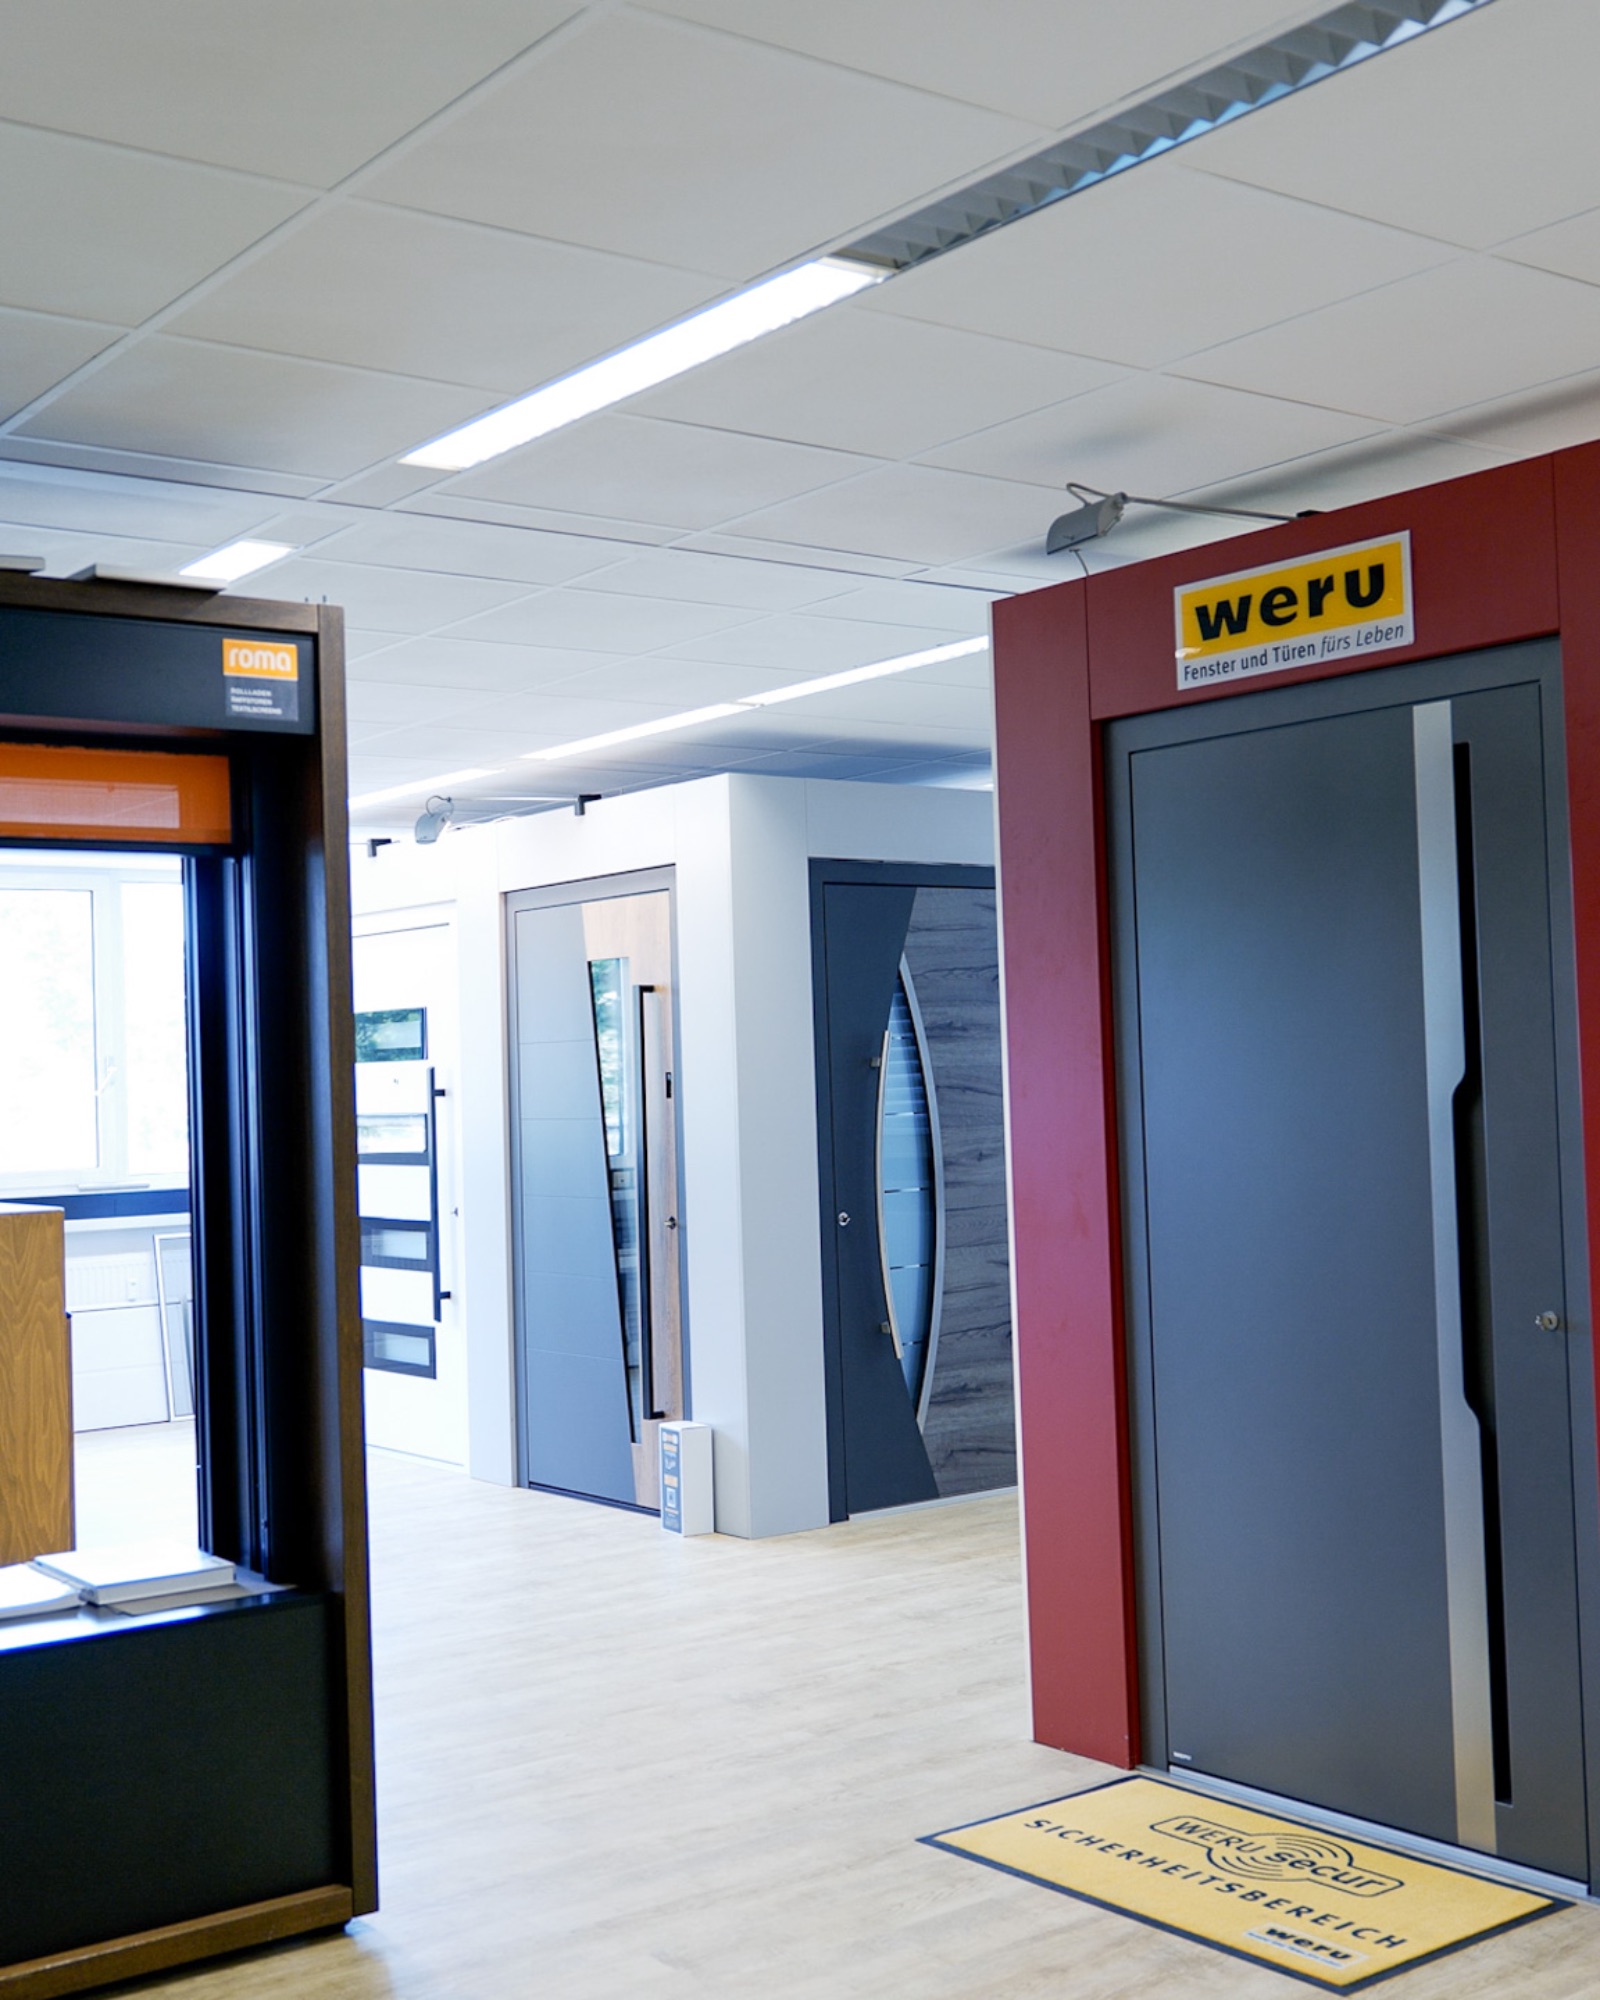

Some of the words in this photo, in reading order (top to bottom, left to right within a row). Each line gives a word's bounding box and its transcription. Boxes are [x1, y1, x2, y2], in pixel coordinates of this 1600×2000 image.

[1194, 562, 1385, 642] weru
[229, 648, 291, 672] roma
[1183, 658, 1236, 682] Fenster
[1240, 650, 1268, 670] und
[1273, 643, 1316, 664] Türen
[1320, 634, 1352, 658] fürs
[1355, 624, 1405, 648] Leben
[1023, 1818, 1409, 1950] SICHERHEITSBEREICH
[1172, 1820, 1267, 1856] WERU
[1263, 1850, 1388, 1890] secur
[1265, 1927, 1353, 1961] weru
